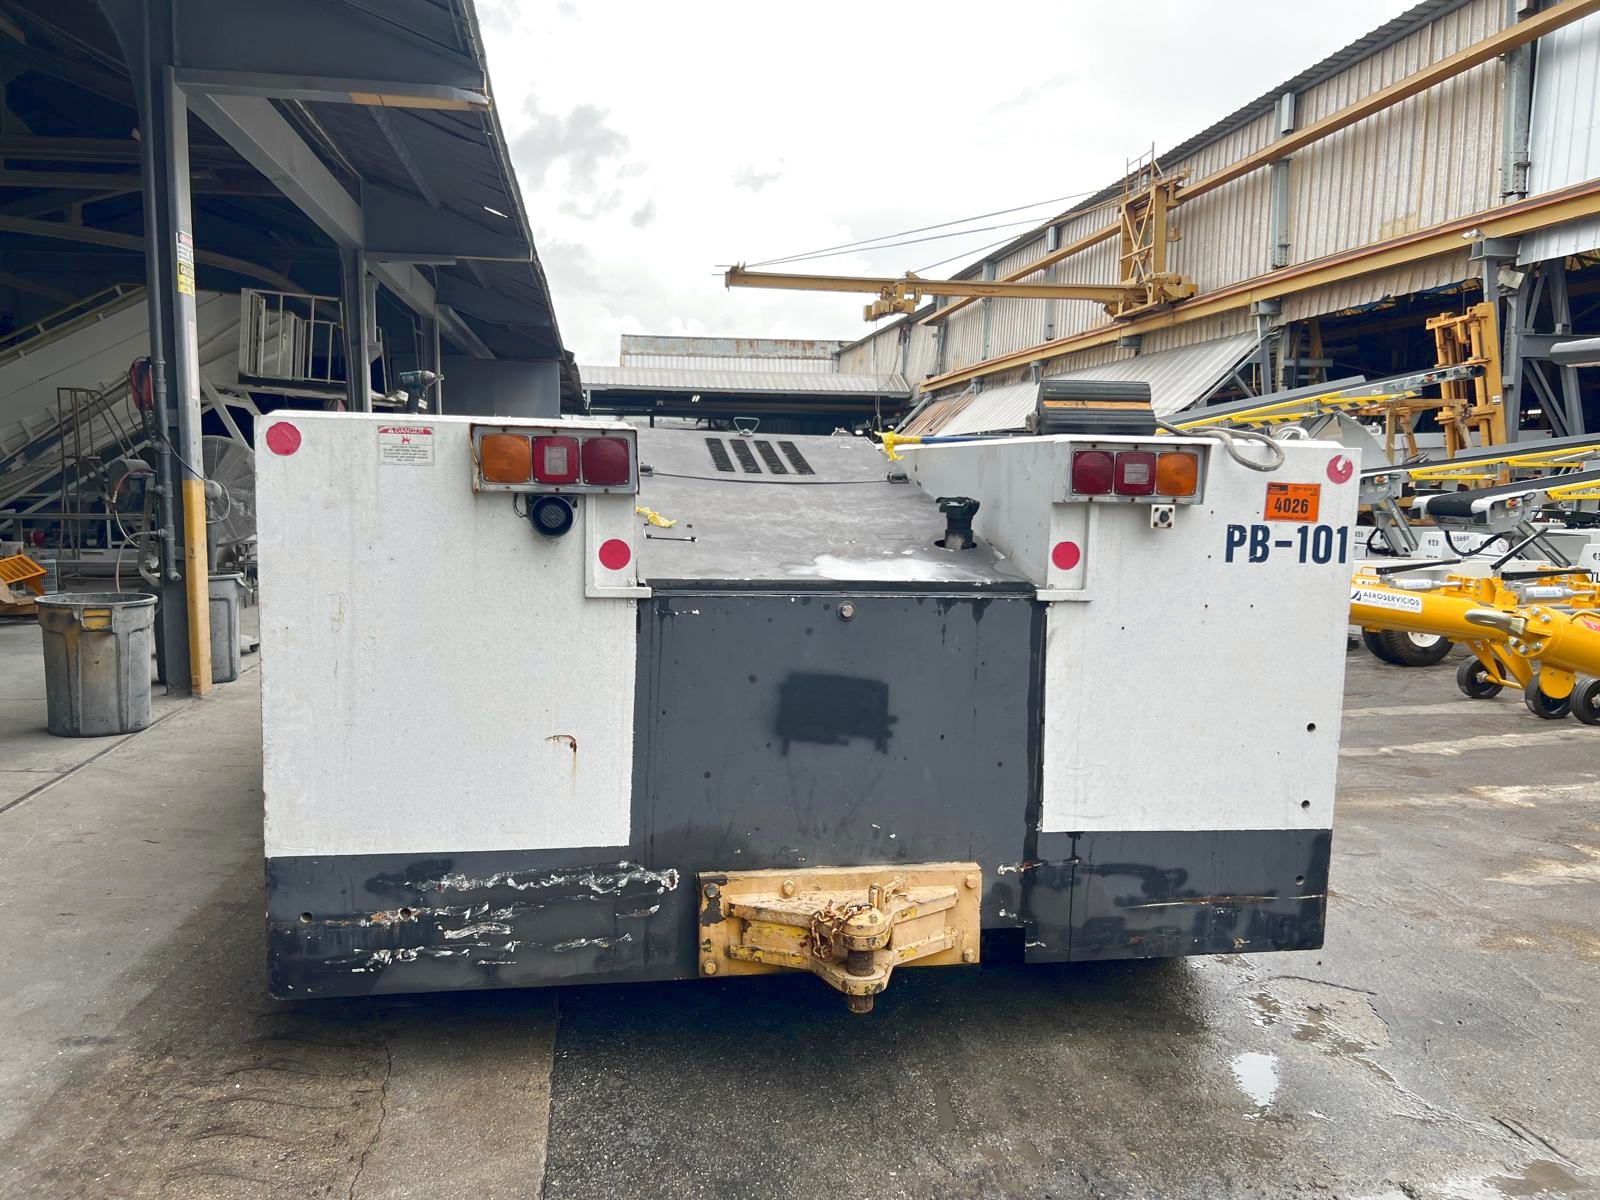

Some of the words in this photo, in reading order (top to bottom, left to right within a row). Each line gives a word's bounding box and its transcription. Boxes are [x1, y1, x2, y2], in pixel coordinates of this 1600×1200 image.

[394, 426, 424, 435] DANGER
[1274, 497, 1309, 514] 4026
[1225, 524, 1348, 564] PB-101
[1363, 590, 1420, 606] AEROSERVICIOS
